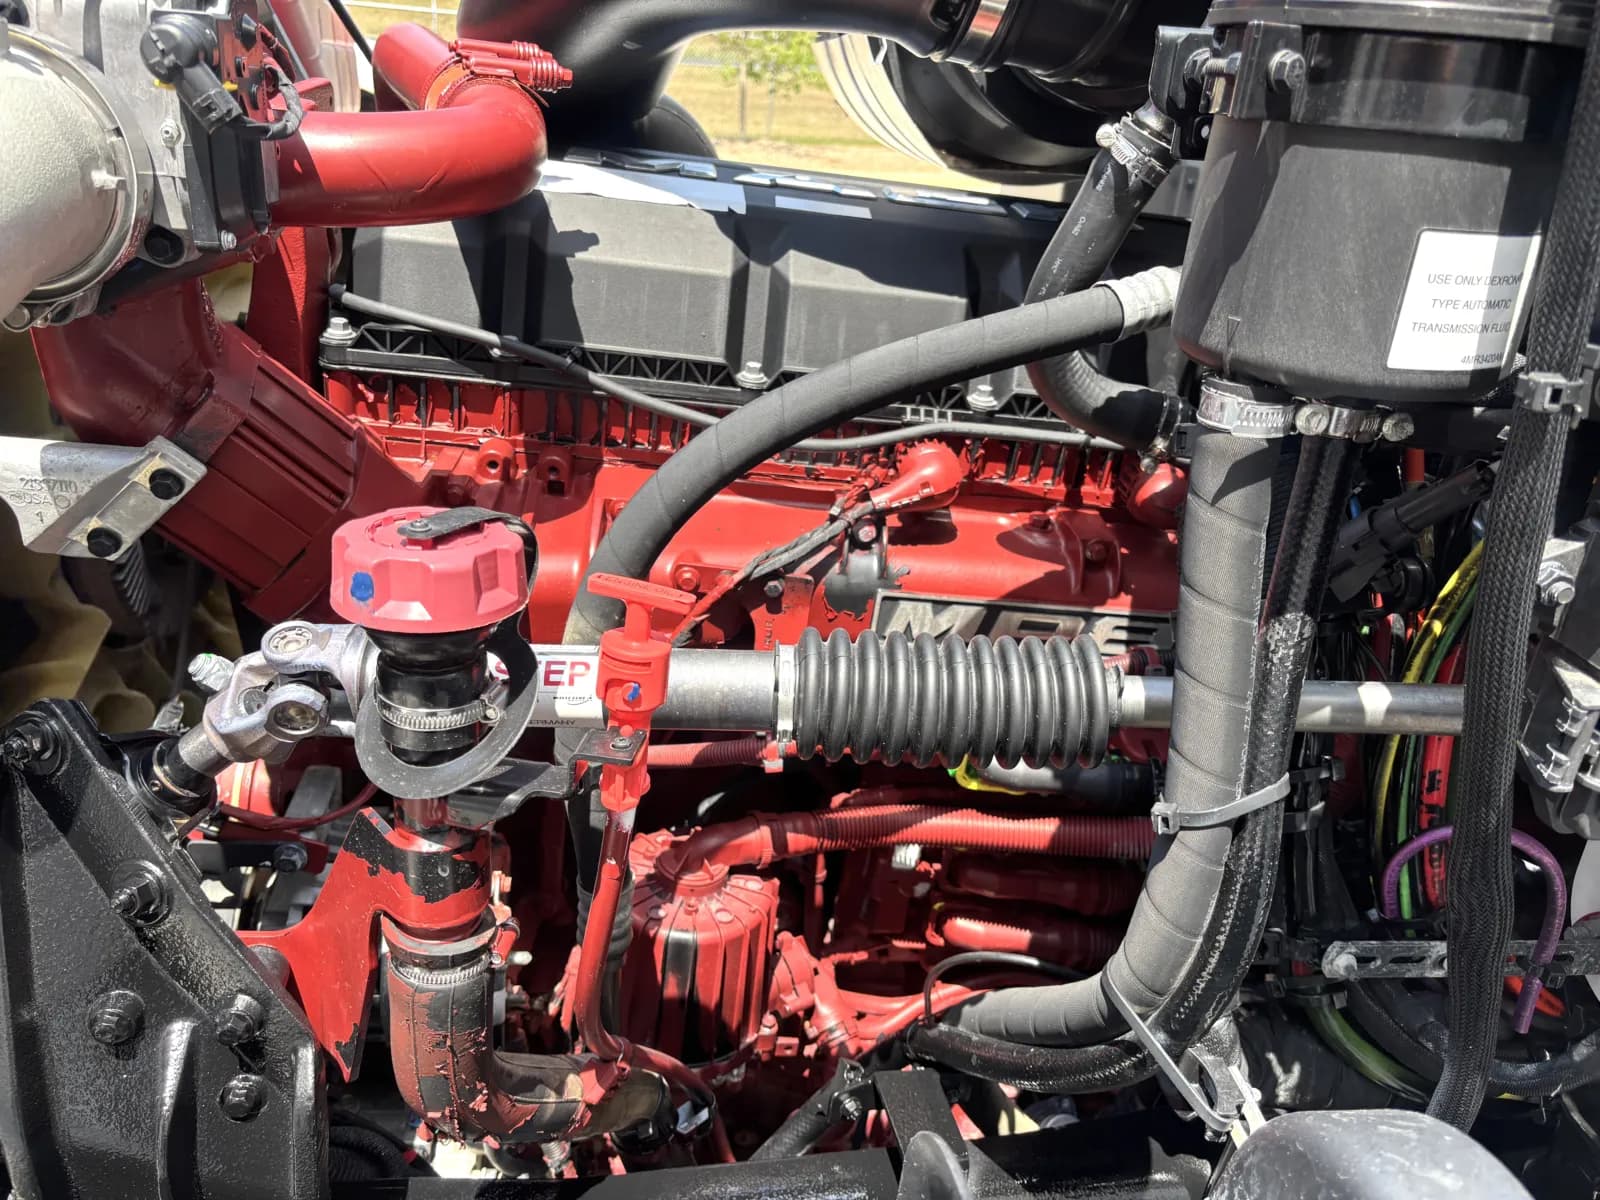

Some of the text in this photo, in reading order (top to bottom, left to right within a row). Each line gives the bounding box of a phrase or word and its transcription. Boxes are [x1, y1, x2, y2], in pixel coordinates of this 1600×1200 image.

[1427, 273, 1452, 285] USE
[1454, 274, 1483, 286] ONLY
[1431, 299, 1512, 310] TYPE AUTOMATIC
[1411, 321, 1489, 334] TRANSMISSION
